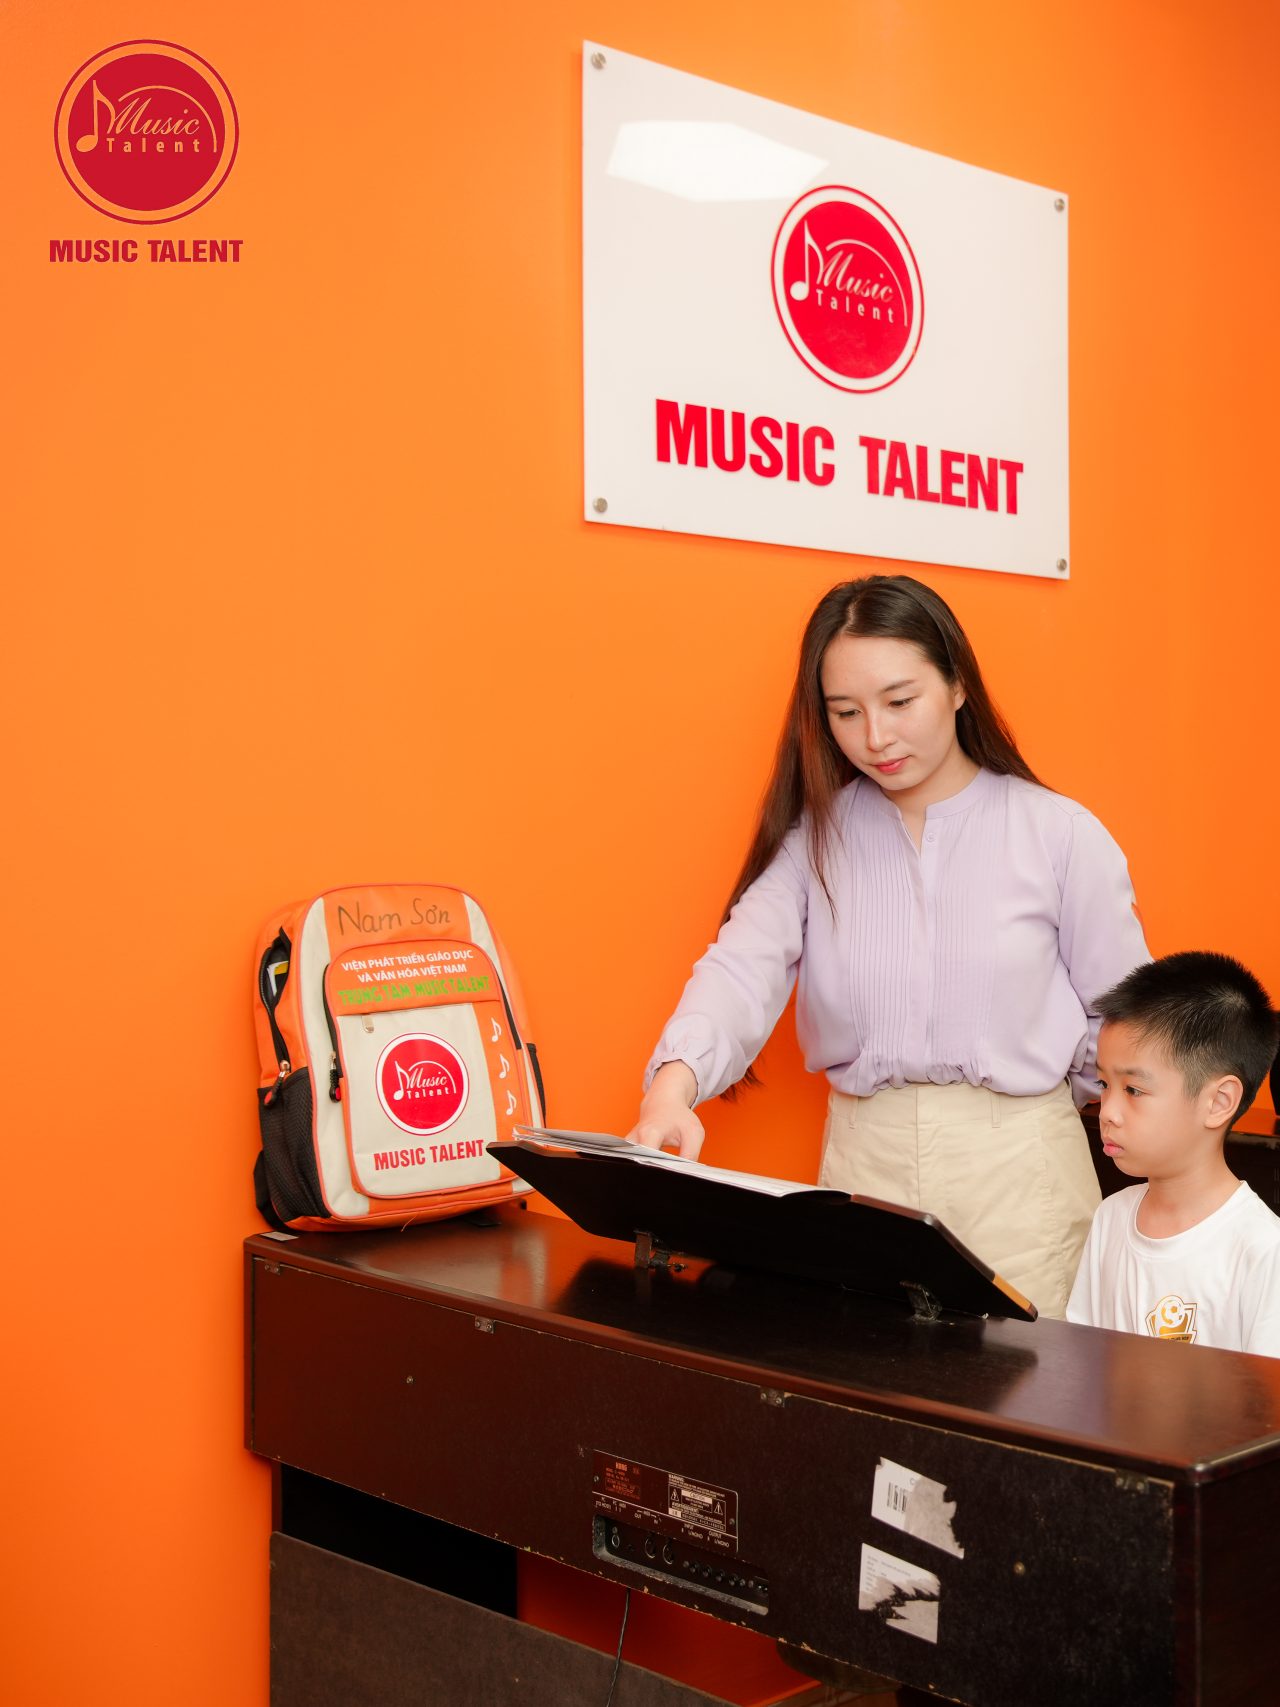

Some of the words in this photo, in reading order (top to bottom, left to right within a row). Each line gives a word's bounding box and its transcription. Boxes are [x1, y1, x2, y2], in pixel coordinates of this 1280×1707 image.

[818, 248, 895, 304] Music
[815, 287, 895, 325] Talent
[655, 398, 836, 487] MUSIC
[858, 434, 1025, 516] TALENT
[337, 901, 402, 935] Nam
[409, 897, 450, 925] Sơn
[443, 963, 467, 973] NAM
[413, 978, 449, 997] MUSIC
[448, 976, 489, 992] TALENT
[405, 1067, 449, 1090] Music
[406, 1087, 449, 1100] Talent
[374, 1147, 426, 1171] MUSIC
[429, 1139, 485, 1163] TALENT
